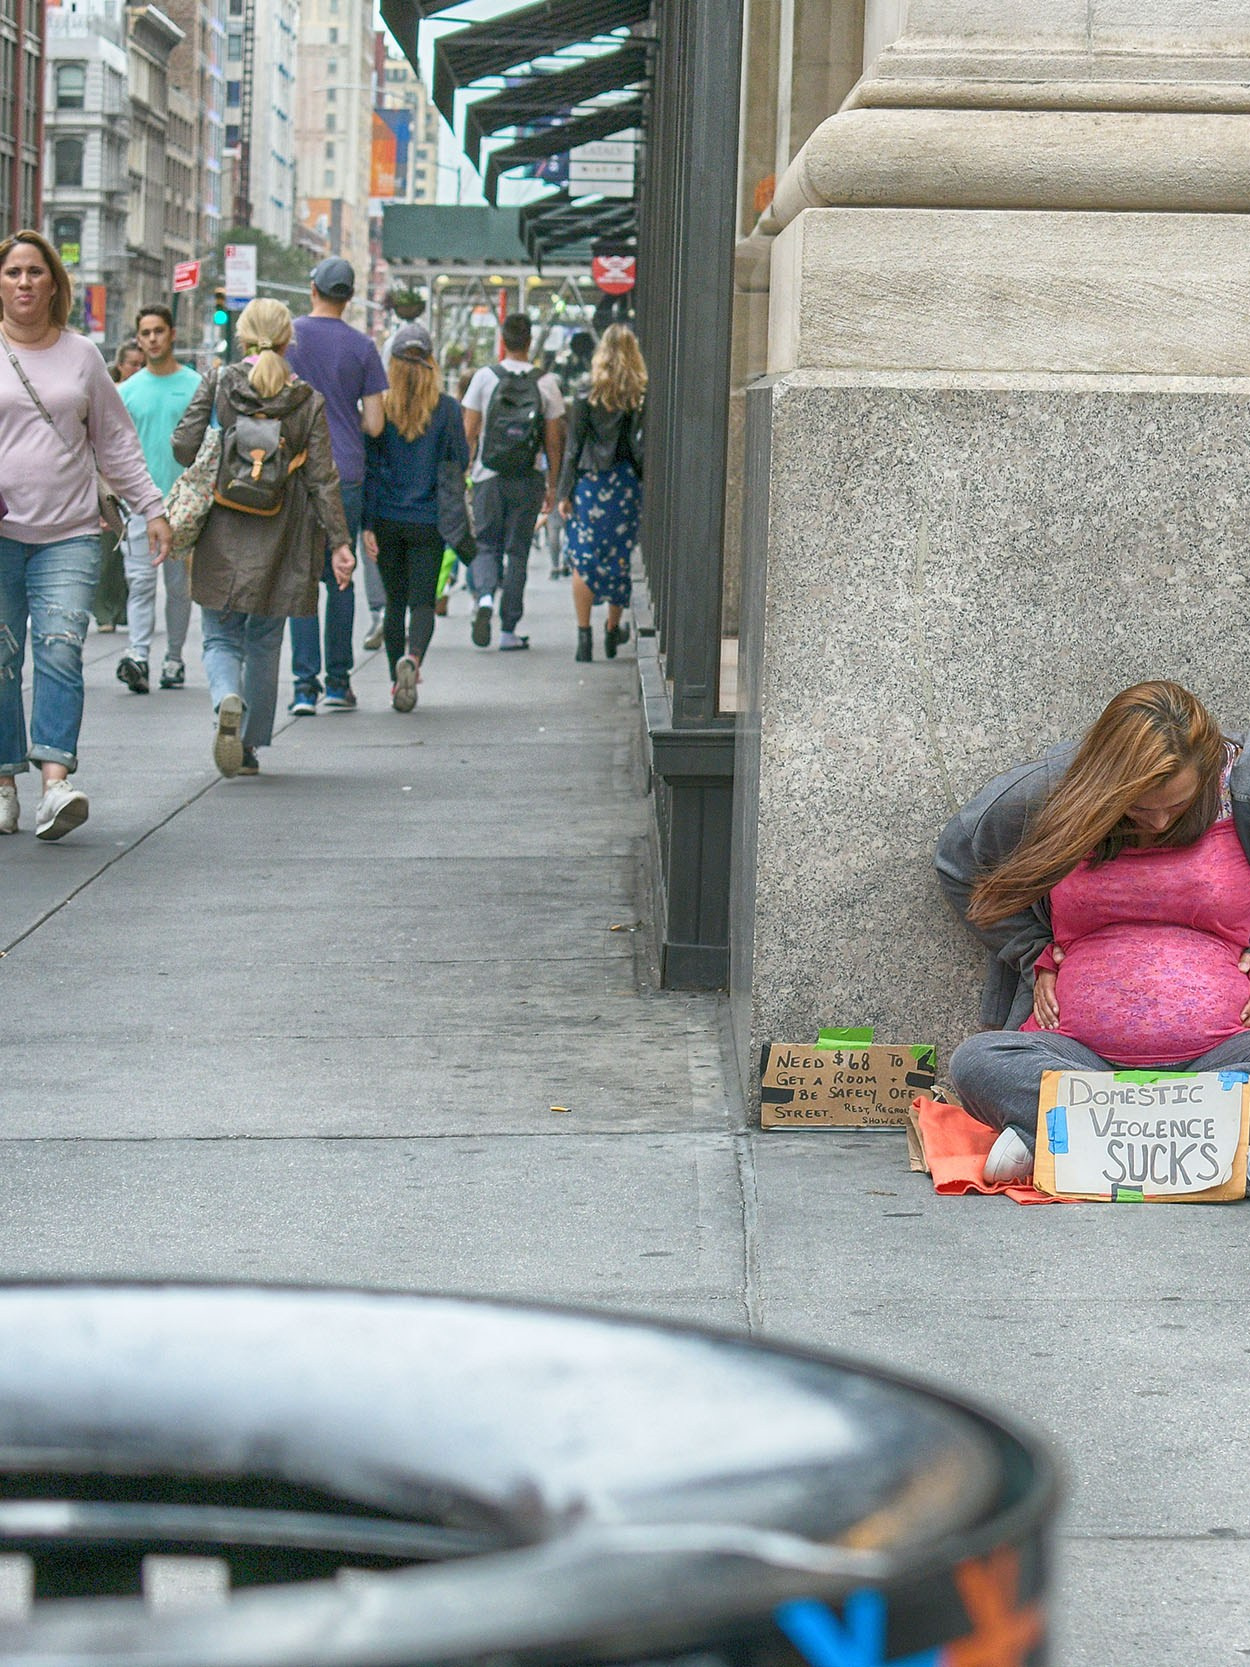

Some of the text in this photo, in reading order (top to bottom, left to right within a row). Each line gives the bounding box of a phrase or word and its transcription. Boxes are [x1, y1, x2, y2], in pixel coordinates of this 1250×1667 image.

[776, 1050, 904, 1071] NEED $68 TO
[776, 1071, 806, 1086] GET
[813, 1077, 823, 1086] A
[833, 1071, 878, 1085] ROOM
[798, 1086, 917, 1105] BE SAFELY OFF
[1068, 1077, 1205, 1107] DOMESTIC
[774, 1105, 834, 1120] STREET.
[875, 1102, 910, 1115] REGROU
[862, 1116, 906, 1125] SHOWER
[1088, 1106, 1216, 1140] VIOLENCE
[1101, 1139, 1220, 1186] SUCKS
